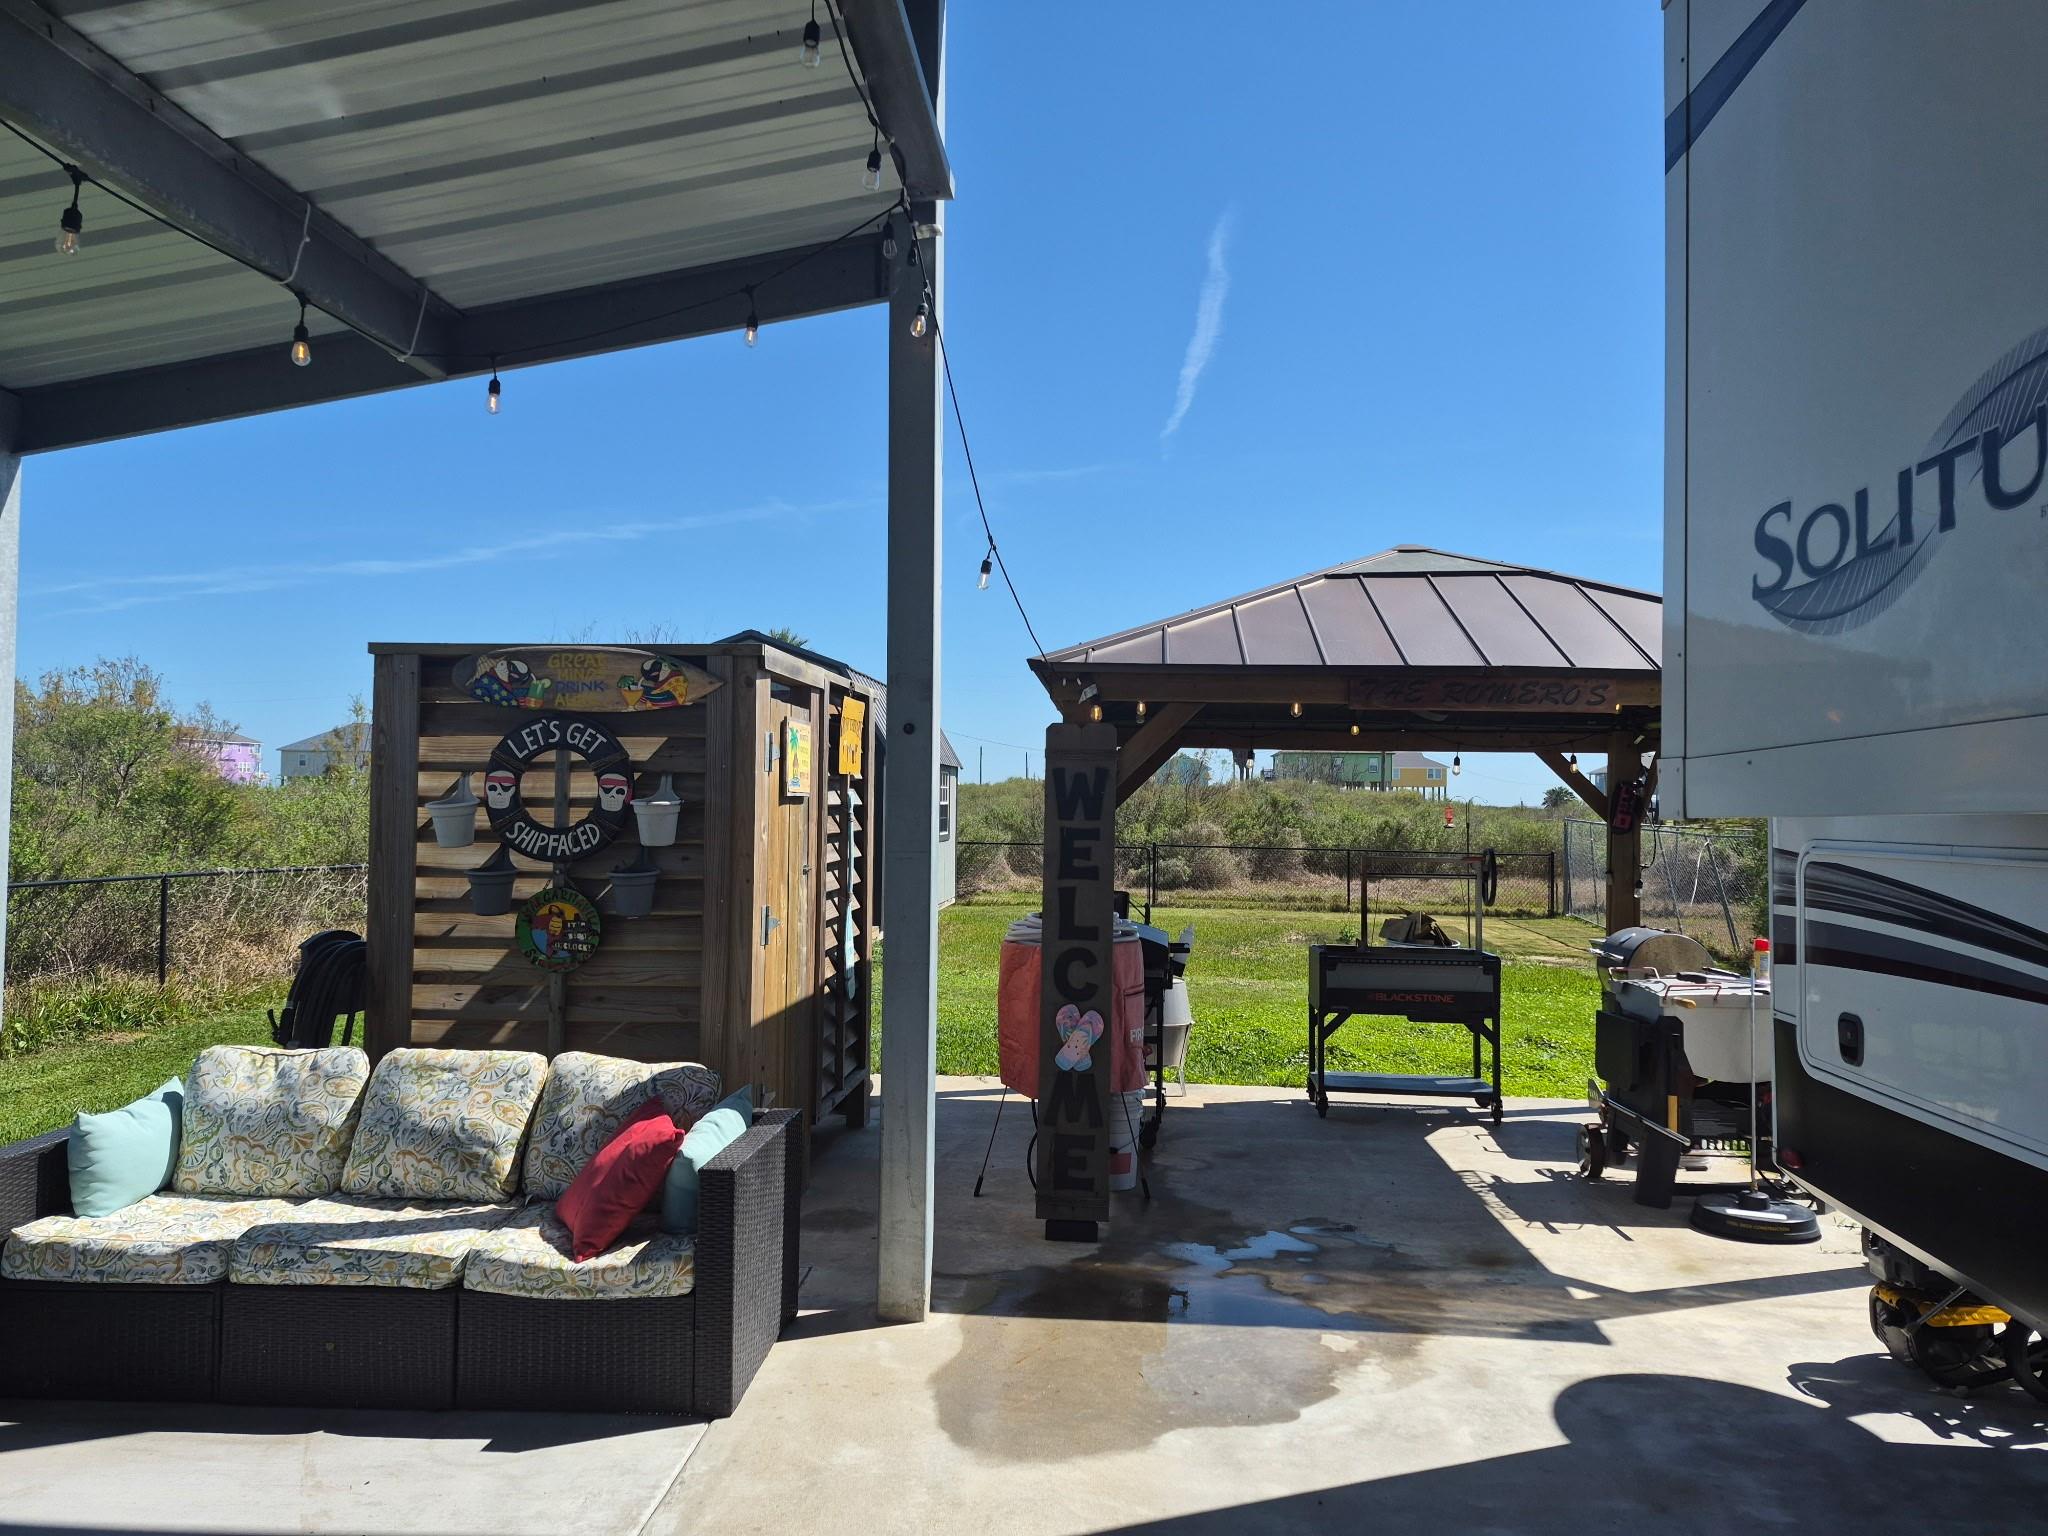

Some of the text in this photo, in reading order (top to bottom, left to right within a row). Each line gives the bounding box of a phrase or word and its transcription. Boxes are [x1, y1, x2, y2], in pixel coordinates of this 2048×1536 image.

[506, 719, 608, 759] LET'S GET
[505, 821, 601, 857] SHIPFACED
[1375, 992, 1456, 1005] BLACKSTONE
